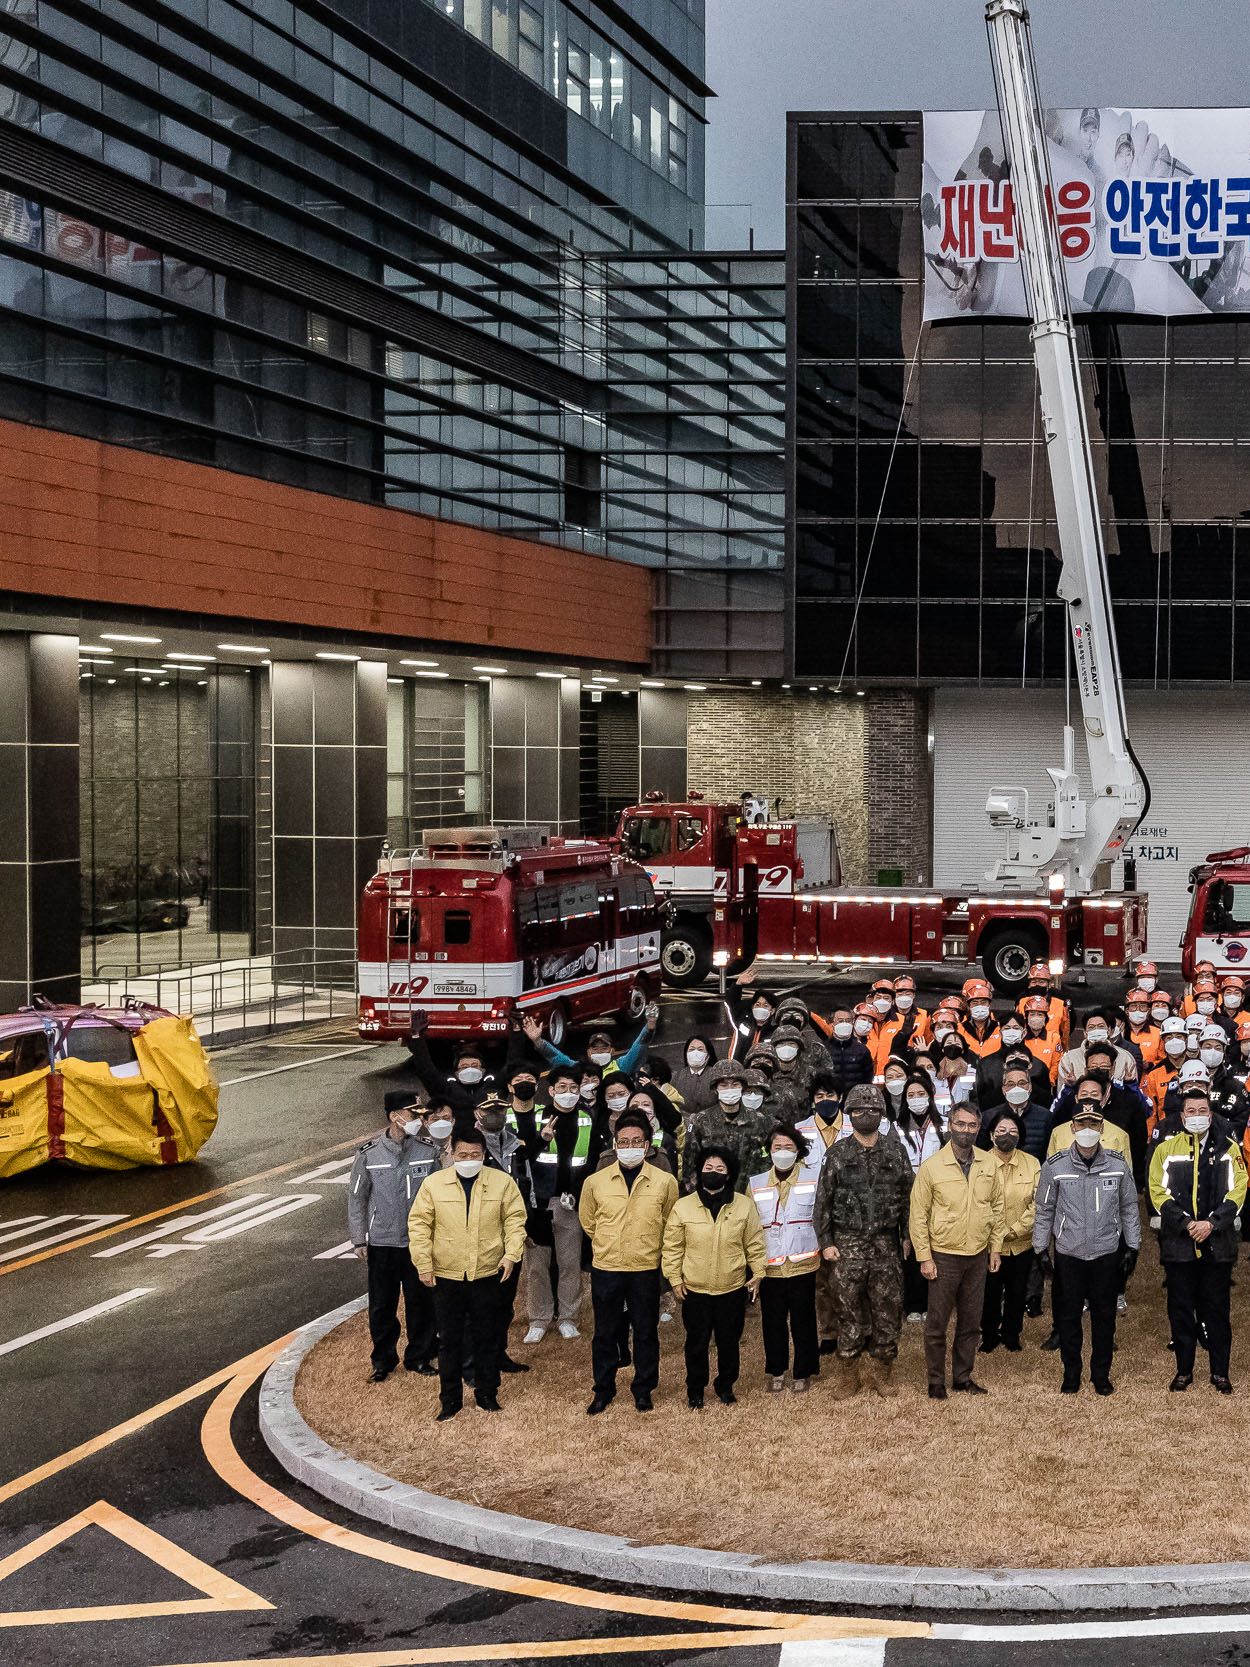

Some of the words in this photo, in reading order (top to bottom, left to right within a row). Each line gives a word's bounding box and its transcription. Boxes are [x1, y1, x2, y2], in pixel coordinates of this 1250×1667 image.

[940, 180, 1092, 259] 재난응
[1139, 845, 1179, 861] 차고지
[388, 976, 430, 996] 119
